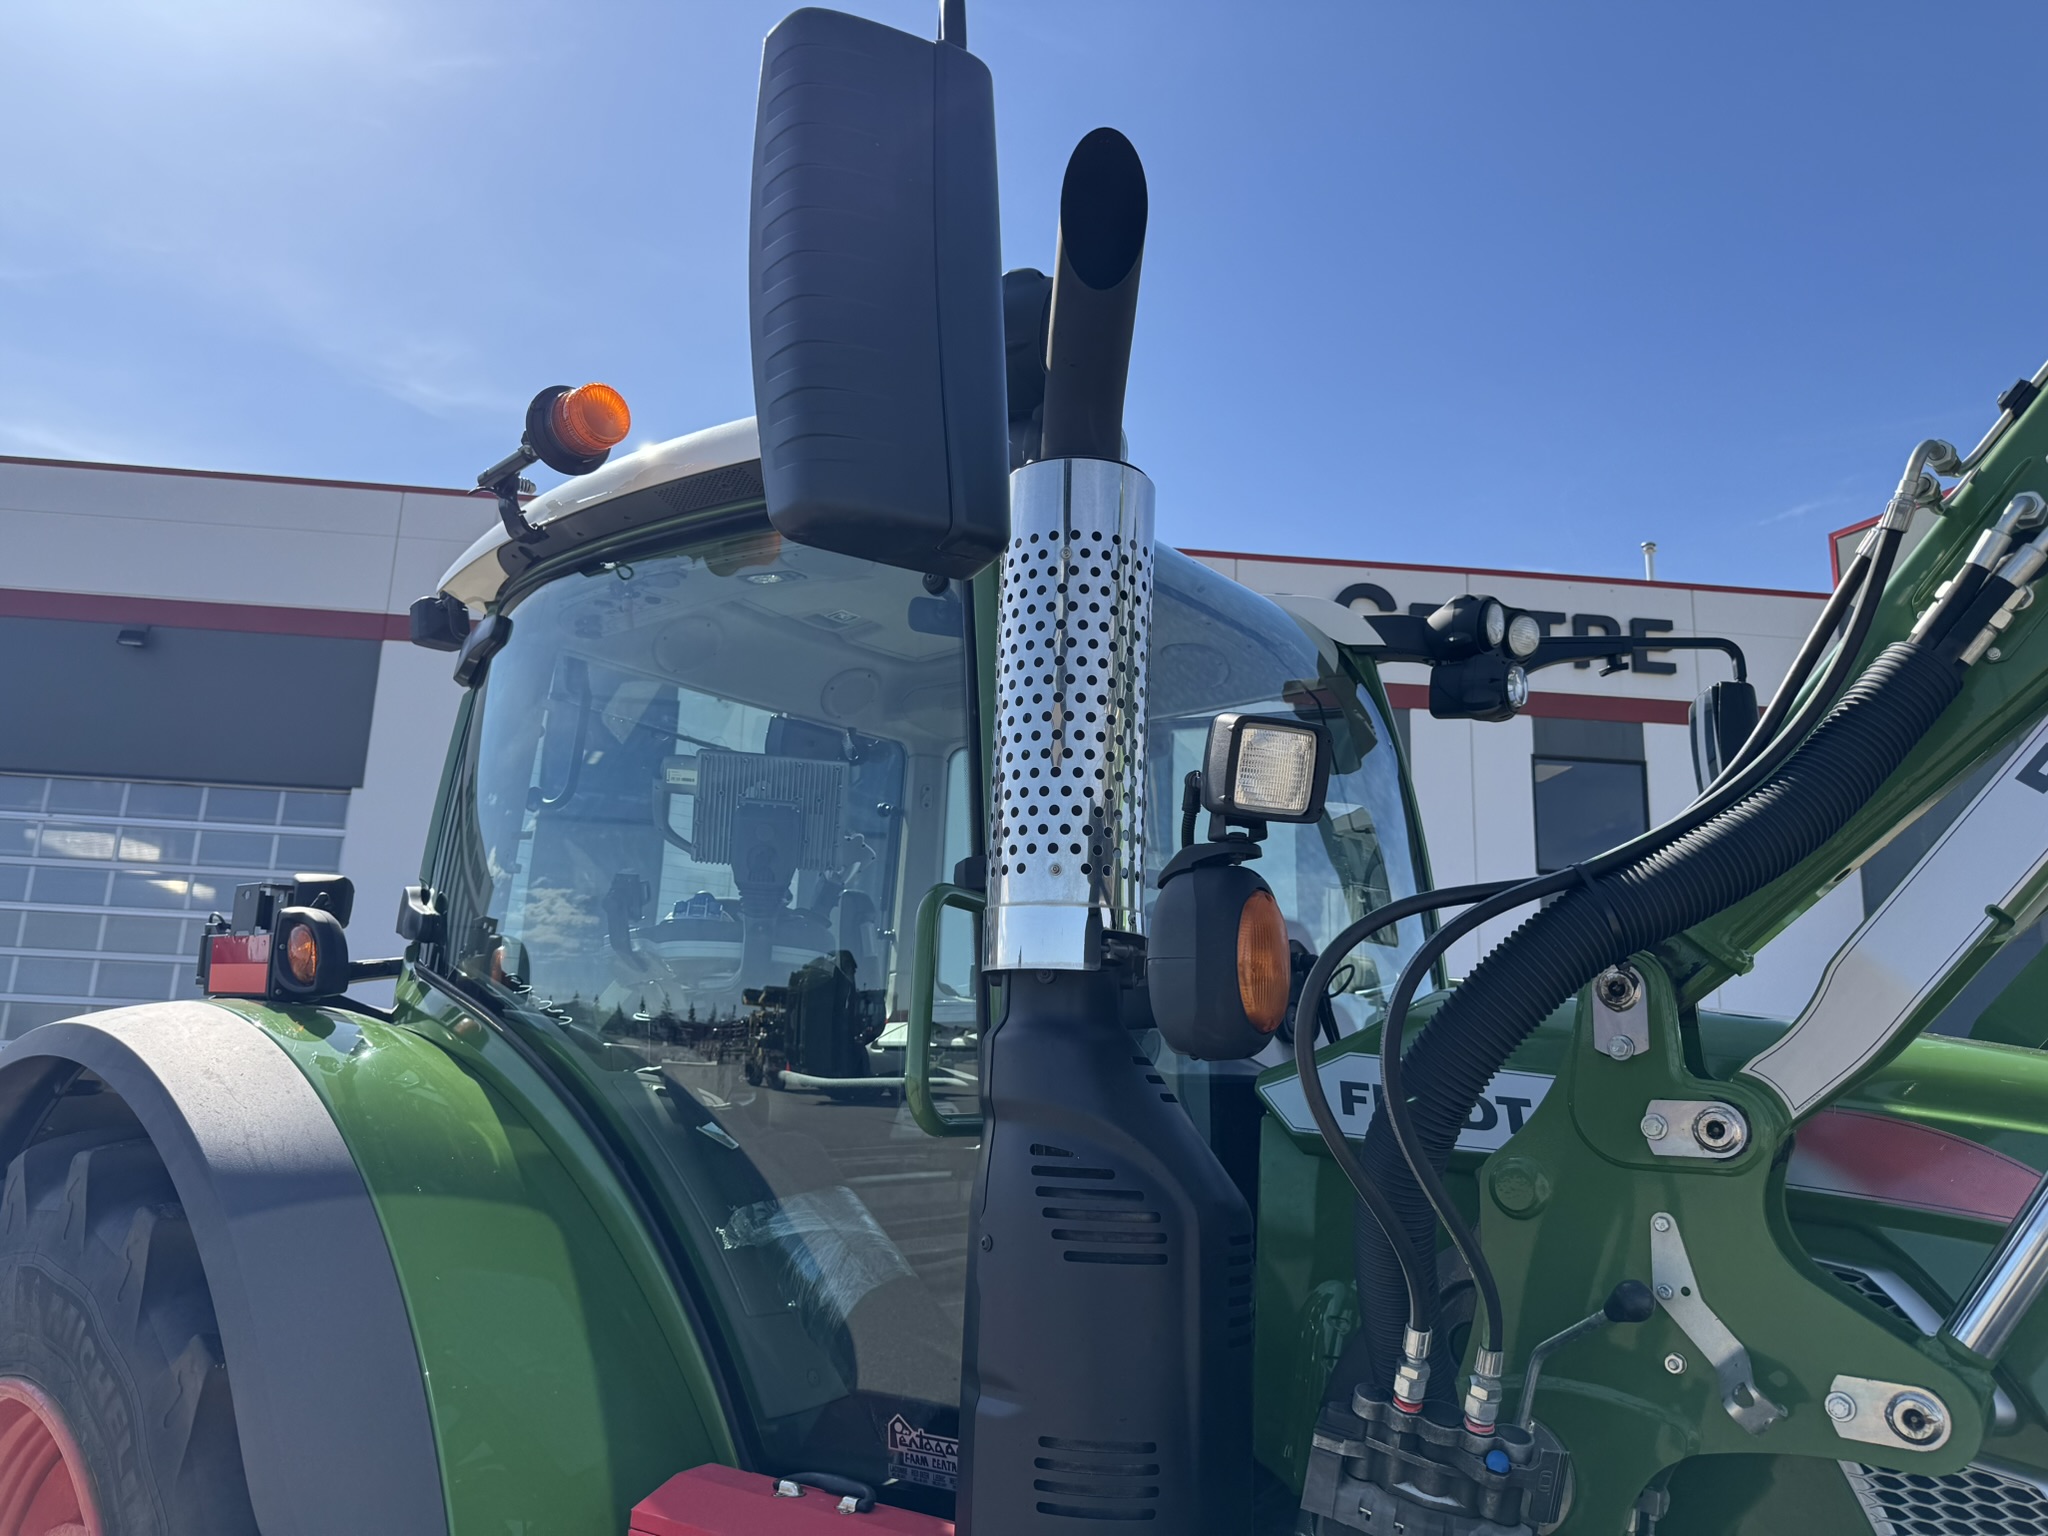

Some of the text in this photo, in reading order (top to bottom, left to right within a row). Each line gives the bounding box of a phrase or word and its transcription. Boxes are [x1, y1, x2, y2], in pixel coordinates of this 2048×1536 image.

[1340, 1080, 1532, 1135] FDT
[888, 1414, 959, 1458] Pentago
[904, 1452, 958, 1473] FARM CENTR
